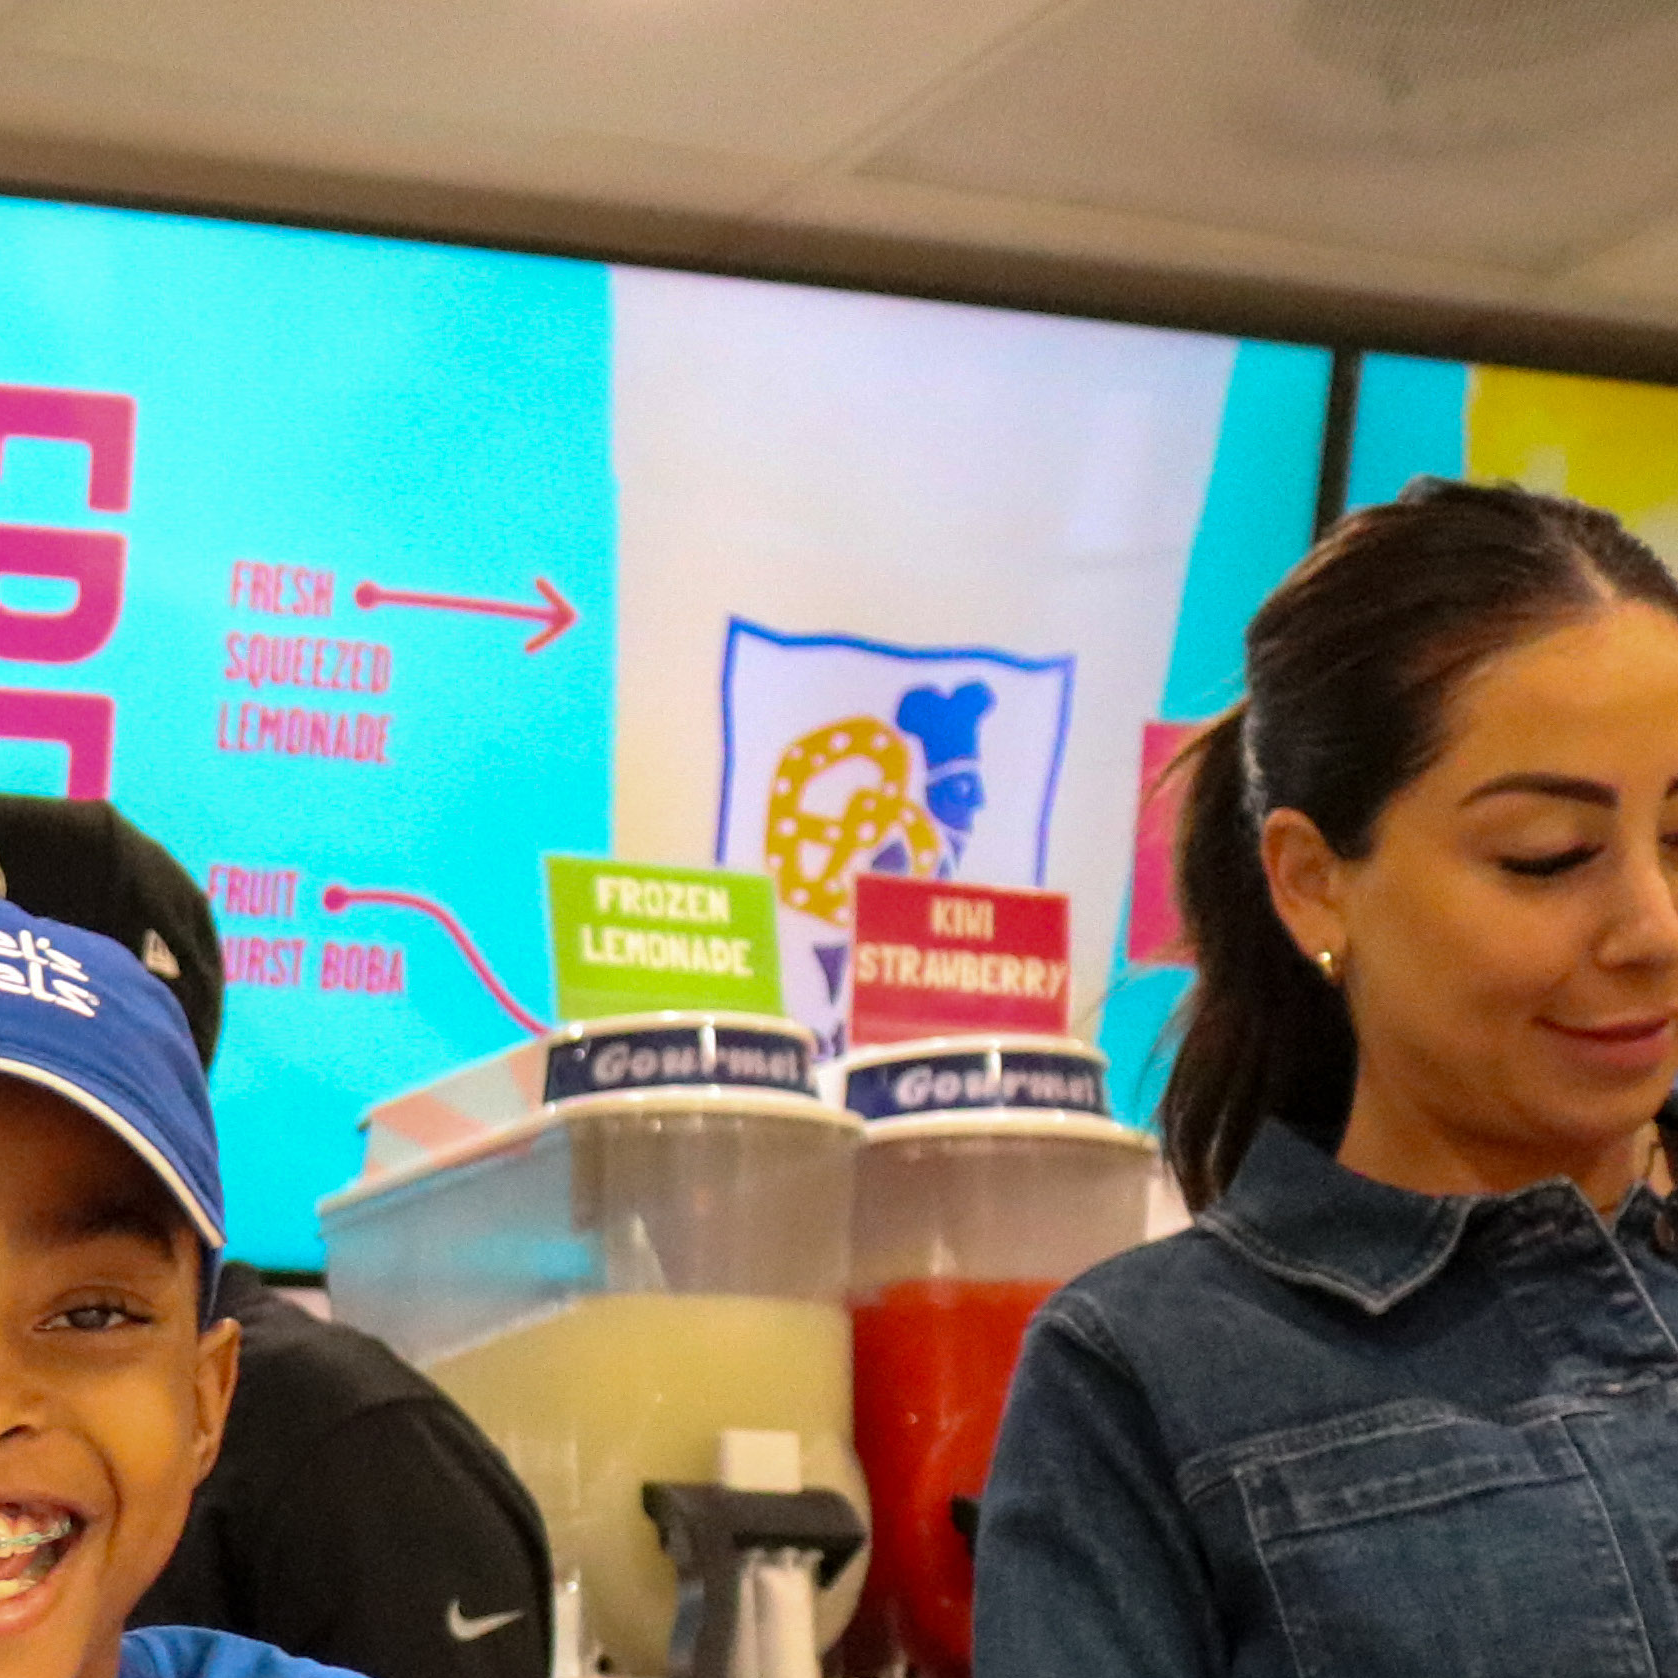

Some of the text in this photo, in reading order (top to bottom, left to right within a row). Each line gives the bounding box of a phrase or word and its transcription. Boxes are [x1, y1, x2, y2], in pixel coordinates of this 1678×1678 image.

[230, 560, 335, 618] FRESH
[224, 631, 393, 694] SQUEEZED
[217, 702, 393, 763] LEMONADE
[208, 864, 299, 917] FRUIT
[594, 874, 731, 925] FROZEN
[928, 896, 994, 941] KIWI
[219, 936, 404, 993] URST BOBA
[579, 922, 755, 977] LEMONADE
[857, 943, 1067, 999] STRAWBERRY
